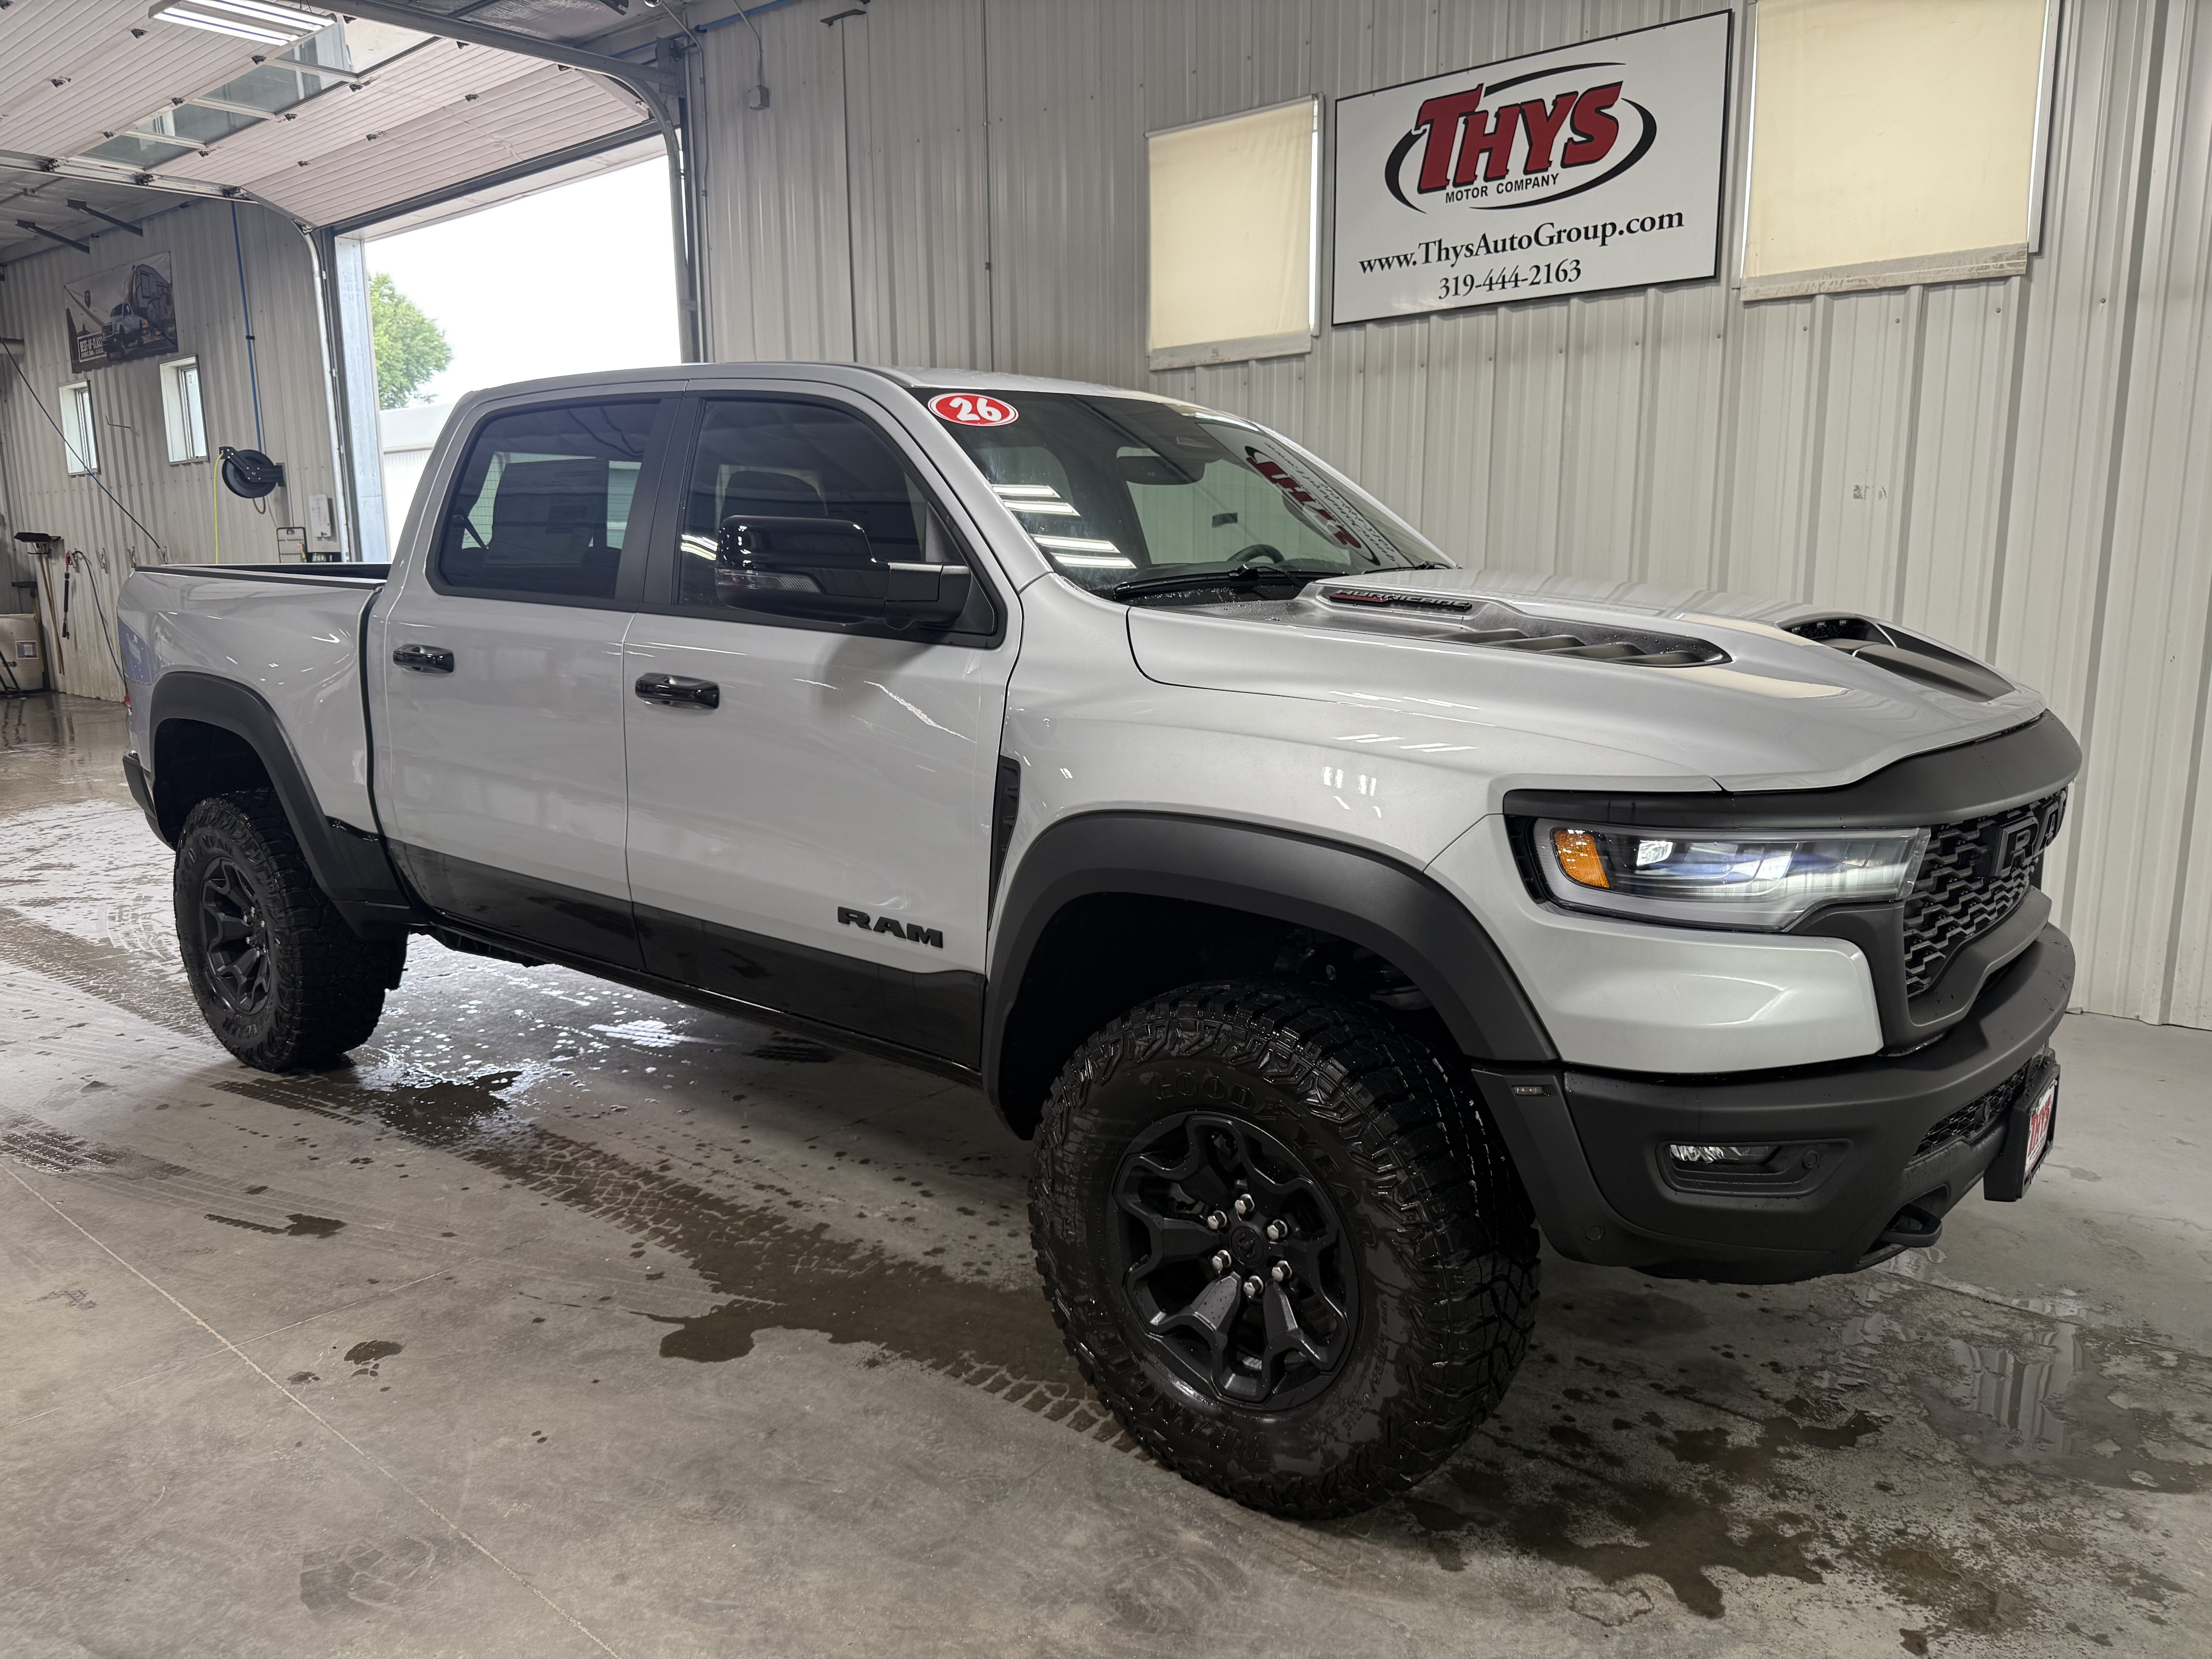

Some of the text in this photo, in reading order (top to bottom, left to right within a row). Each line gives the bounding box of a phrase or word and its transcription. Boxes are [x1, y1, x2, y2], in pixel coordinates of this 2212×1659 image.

[1414, 81, 1623, 194] THYS
[1445, 173, 1559, 203] MOTOR COMPANY
[1358, 211, 1685, 275] www.ThysAutoGroup.com
[1437, 259, 1582, 299] 319-444-2163
[950, 397, 1001, 422] 26
[1336, 589, 1471, 607] HURRICANE
[1995, 790, 2066, 878] RA
[838, 906, 944, 949] RAM
